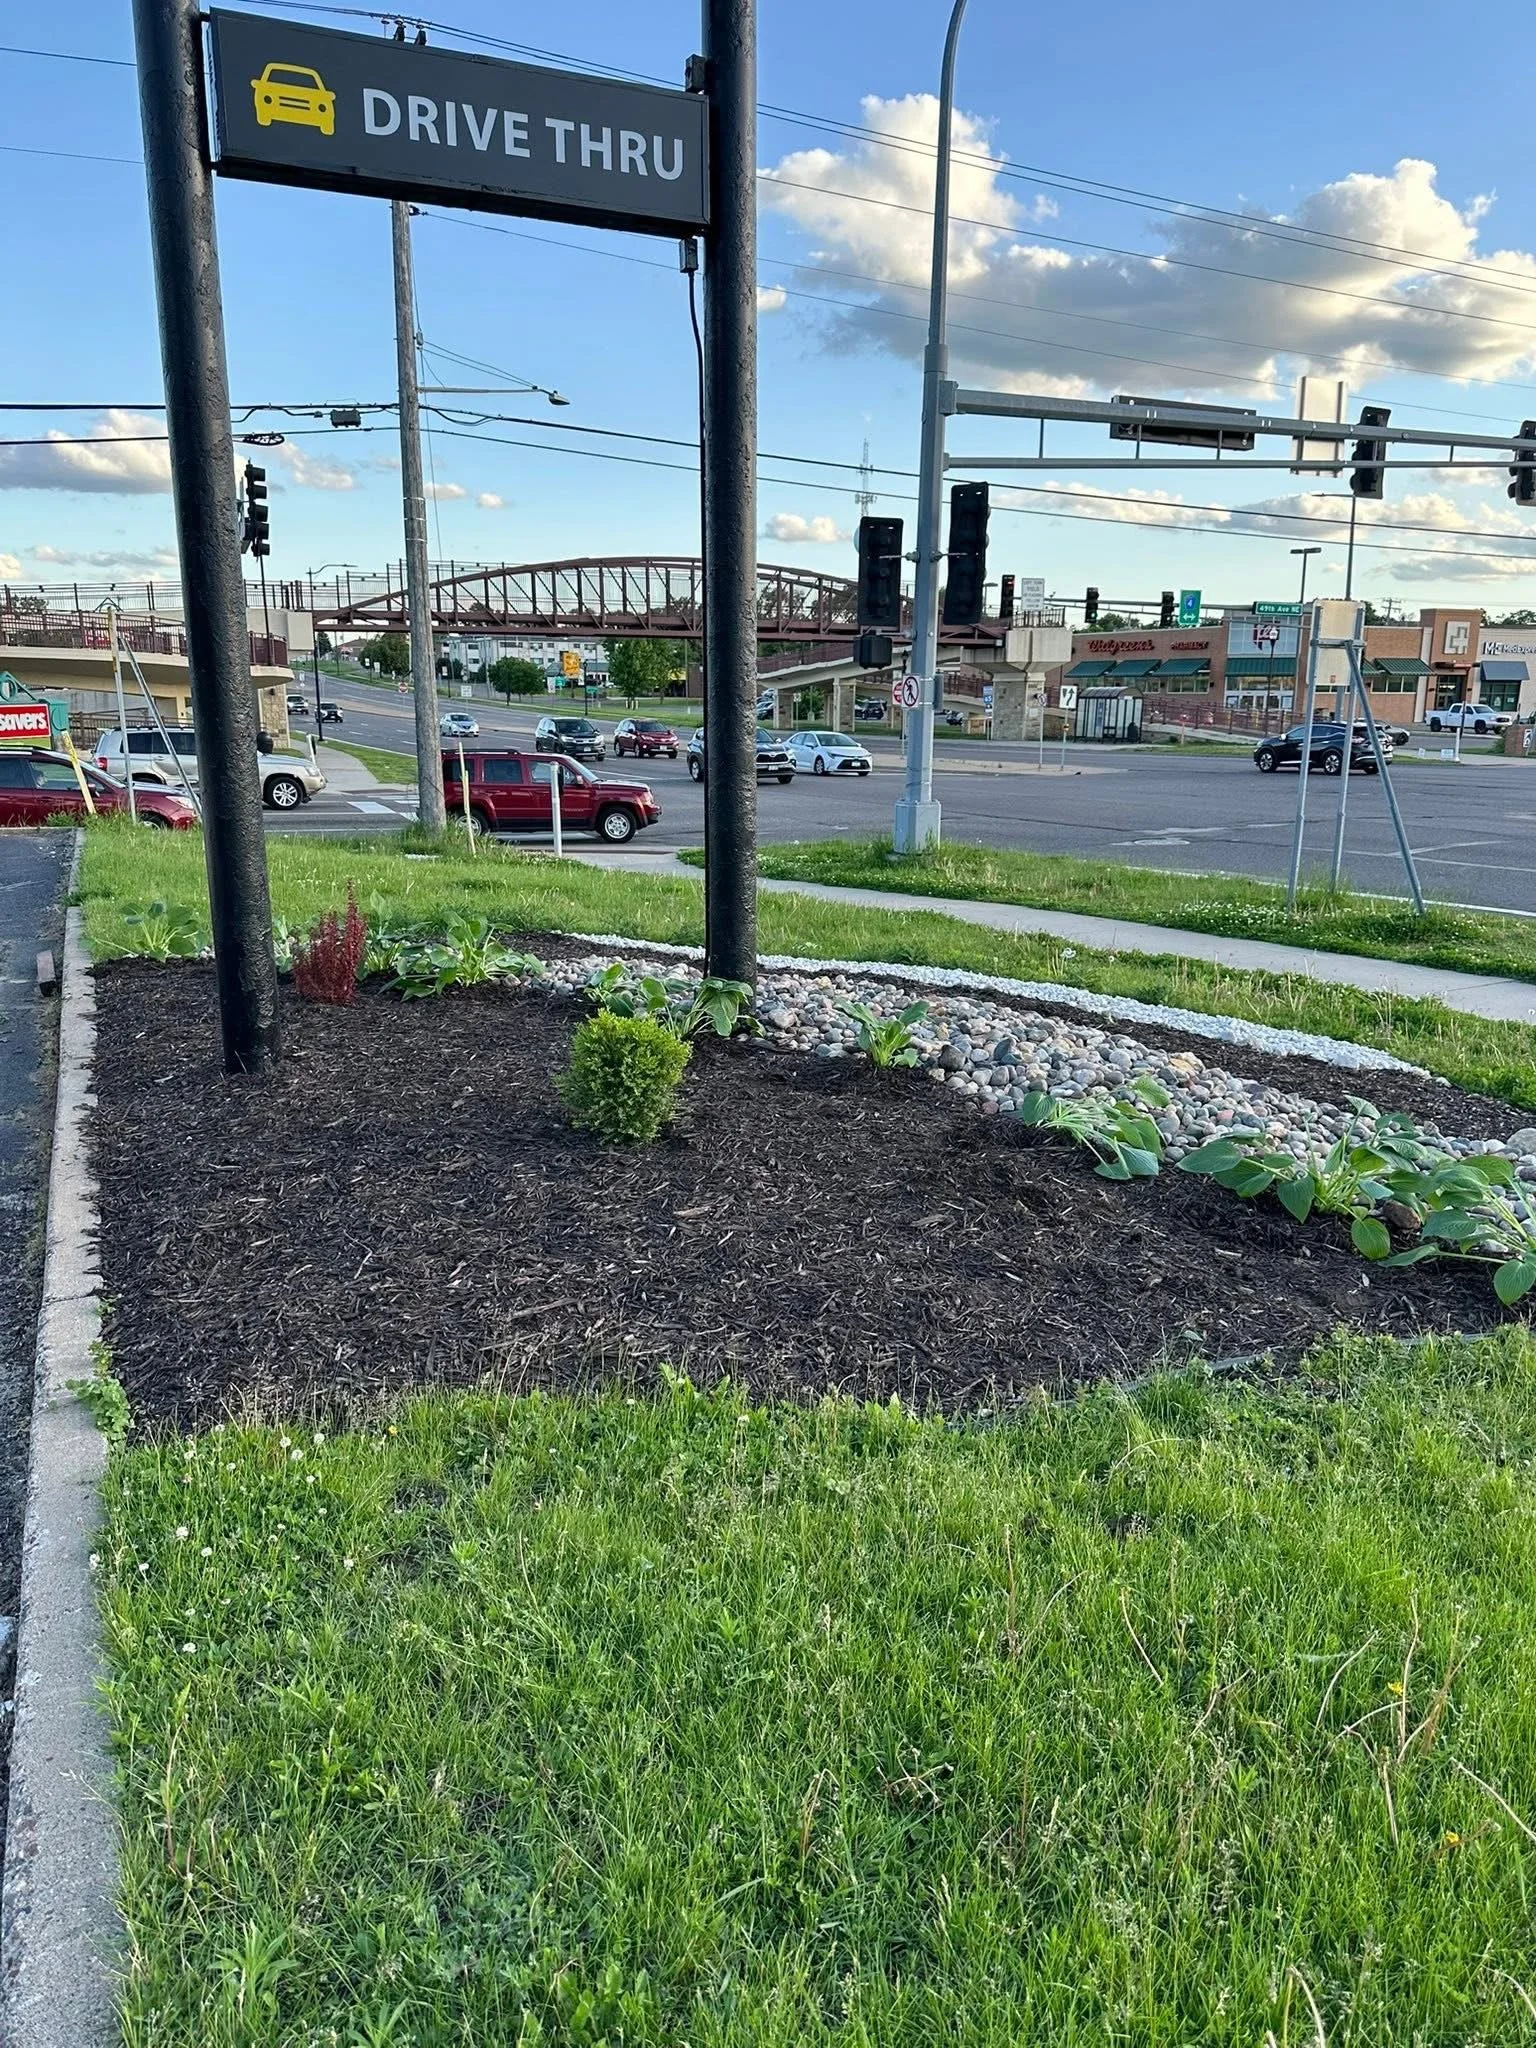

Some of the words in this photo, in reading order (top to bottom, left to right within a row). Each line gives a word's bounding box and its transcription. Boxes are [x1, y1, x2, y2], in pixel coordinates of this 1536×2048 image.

[363, 88, 531, 159] DRIVE
[545, 117, 685, 181] THRU
[1187, 599, 1193, 607] 4
[1259, 604, 1275, 612] 49th
[1088, 640, 1155, 655] Walgreens
